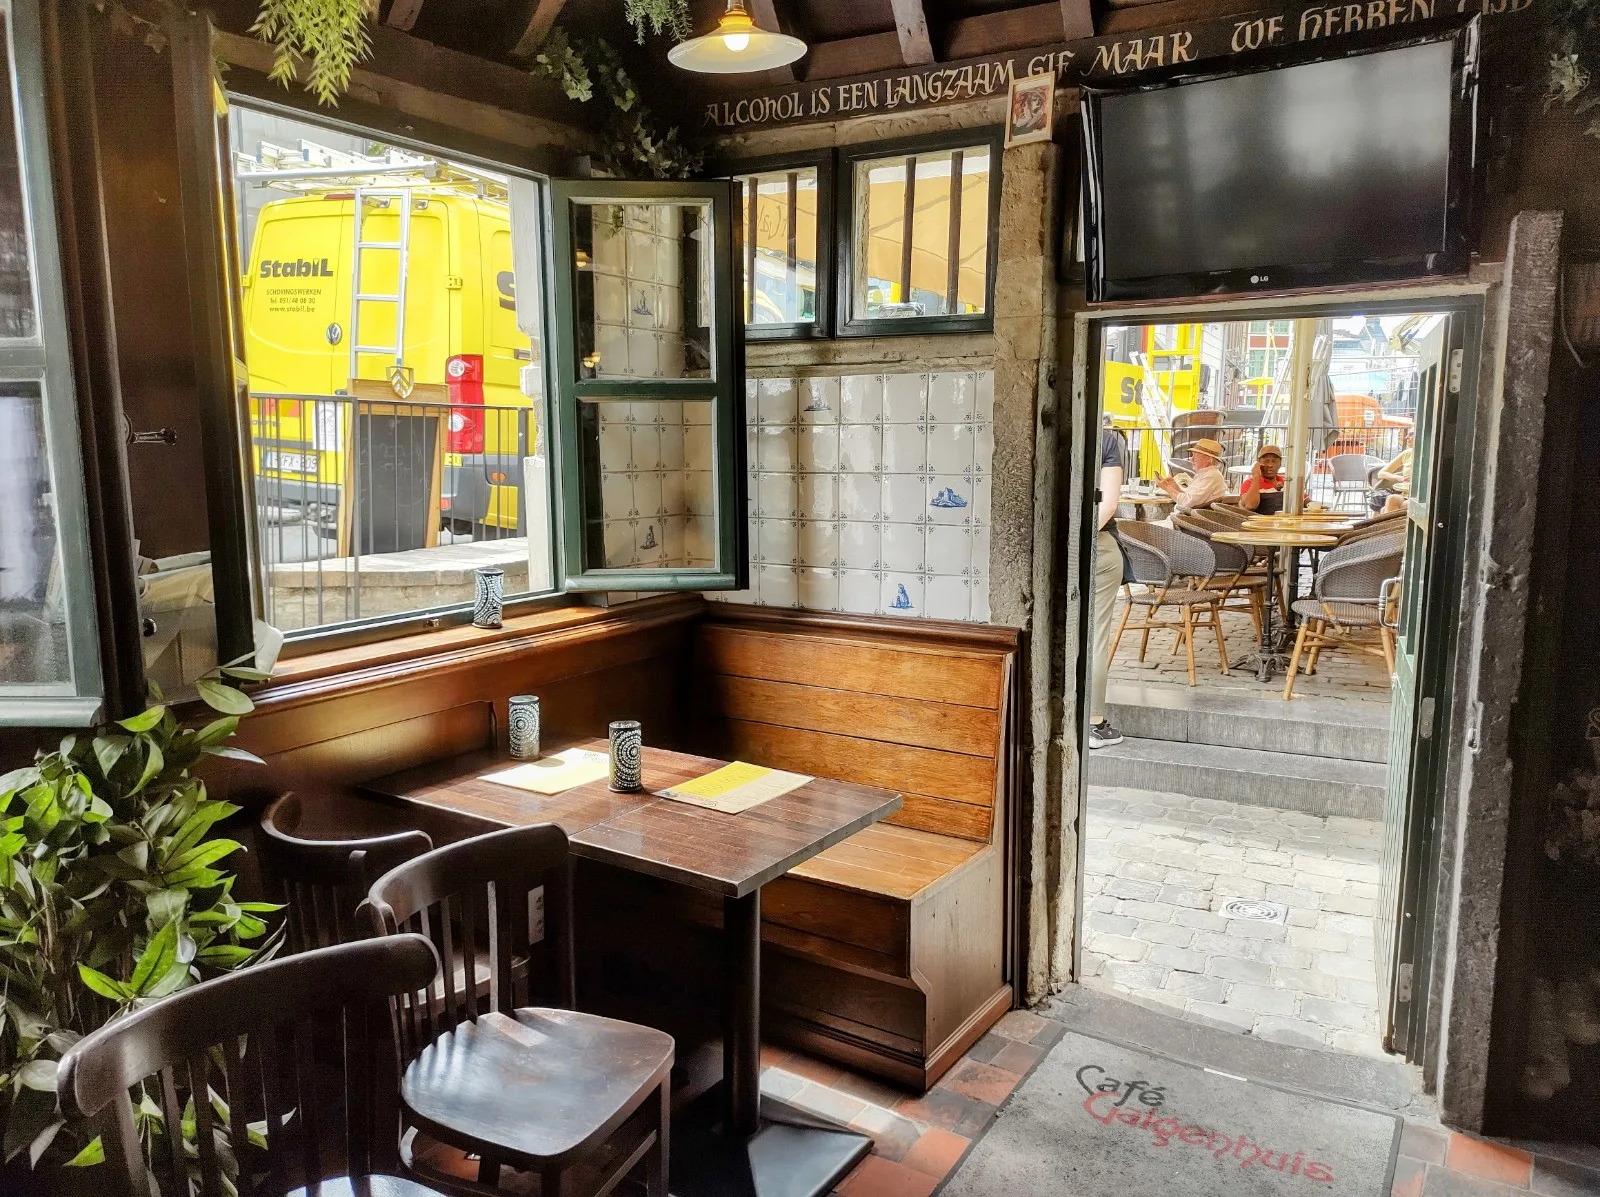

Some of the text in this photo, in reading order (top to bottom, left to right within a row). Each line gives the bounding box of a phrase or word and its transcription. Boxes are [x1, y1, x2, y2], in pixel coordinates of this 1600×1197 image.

[836, 79, 879, 112] EEN
[884, 59, 1015, 108] LANGZAAM
[1028, 51, 1075, 84] GIF
[1079, 31, 1199, 76] MAAR
[1076, 1064, 1168, 1107] Café
